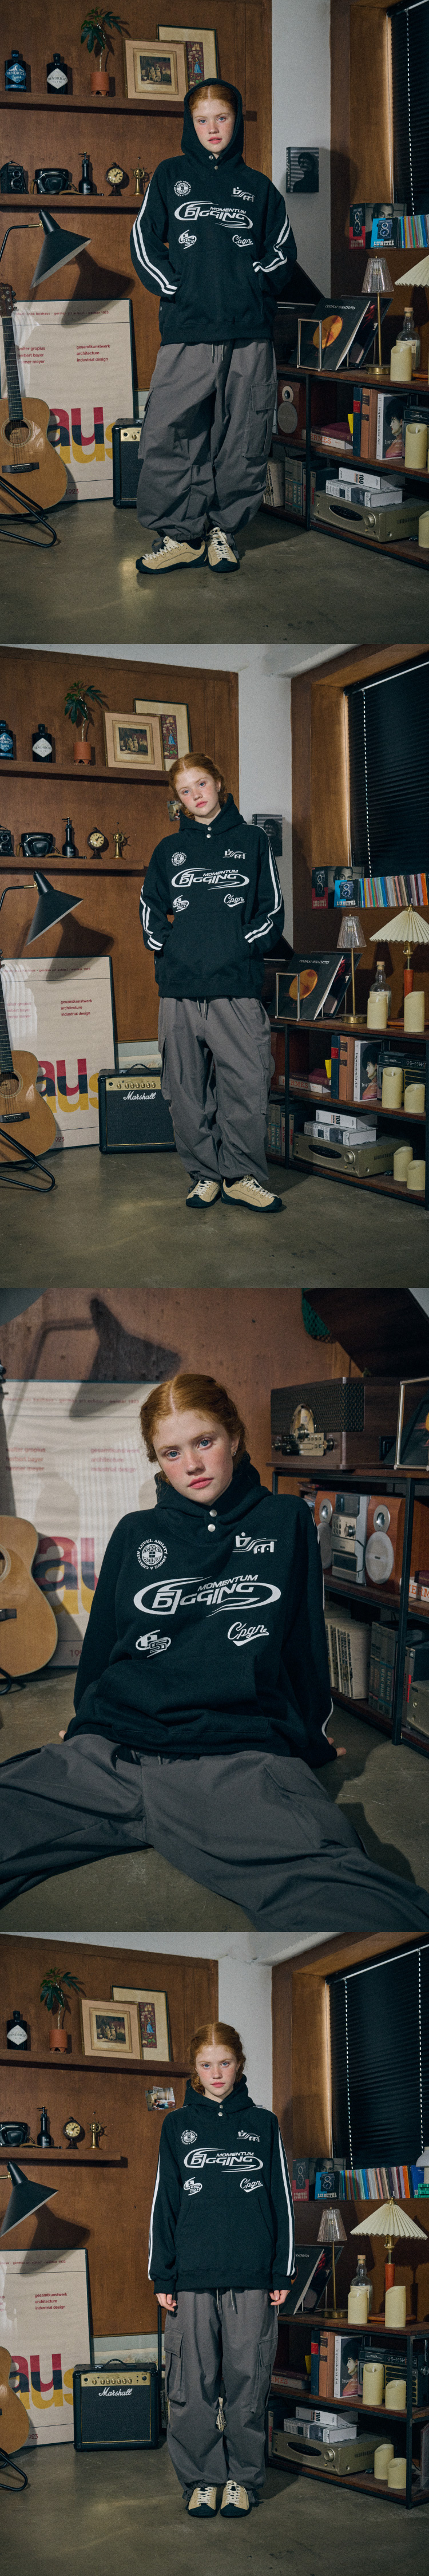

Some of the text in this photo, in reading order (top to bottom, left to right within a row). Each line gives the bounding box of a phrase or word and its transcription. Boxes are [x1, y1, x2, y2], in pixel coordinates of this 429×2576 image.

[123, 1091, 157, 1100] Marshall
[197, 1574, 259, 1591] MOMENTUM
[98, 2387, 133, 2396] Marshall
